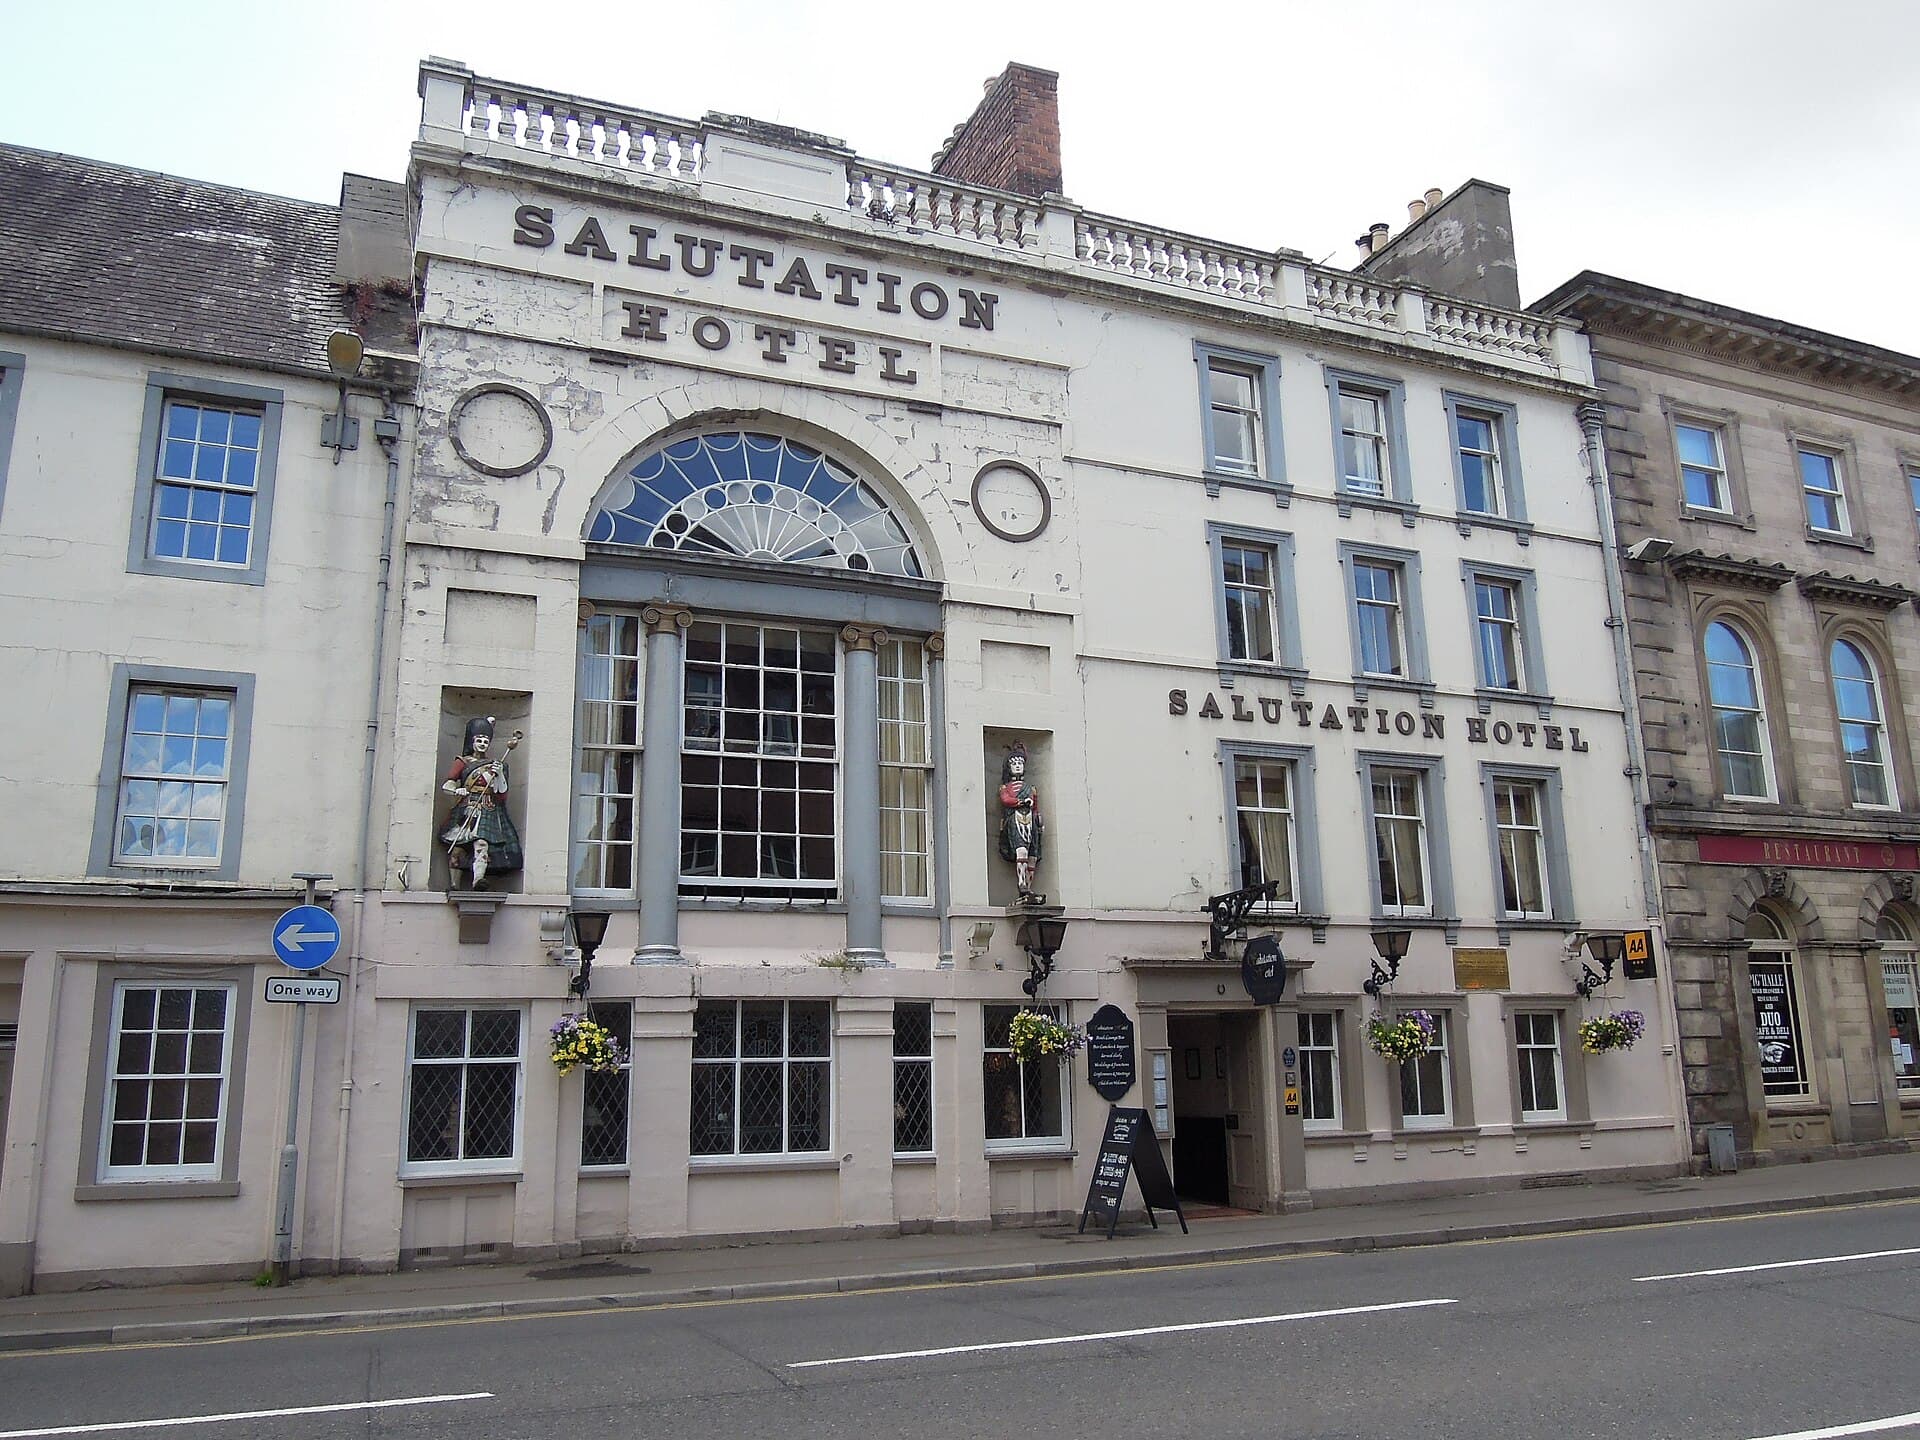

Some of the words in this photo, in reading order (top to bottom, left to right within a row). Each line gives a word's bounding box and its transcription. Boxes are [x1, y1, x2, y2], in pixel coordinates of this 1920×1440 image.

[513, 203, 999, 331] SALUTATION
[620, 300, 917, 385] HOTEL
[1168, 688, 1445, 739] SALUTATION
[1466, 716, 1589, 752] HOTEL
[1763, 842, 1860, 863] RESTAURANT
[1629, 938, 1644, 953] AA
[273, 984, 301, 995] One
[306, 987, 333, 998] way
[1760, 1011, 1781, 1026] DUO
[1286, 1093, 1297, 1102] AA
